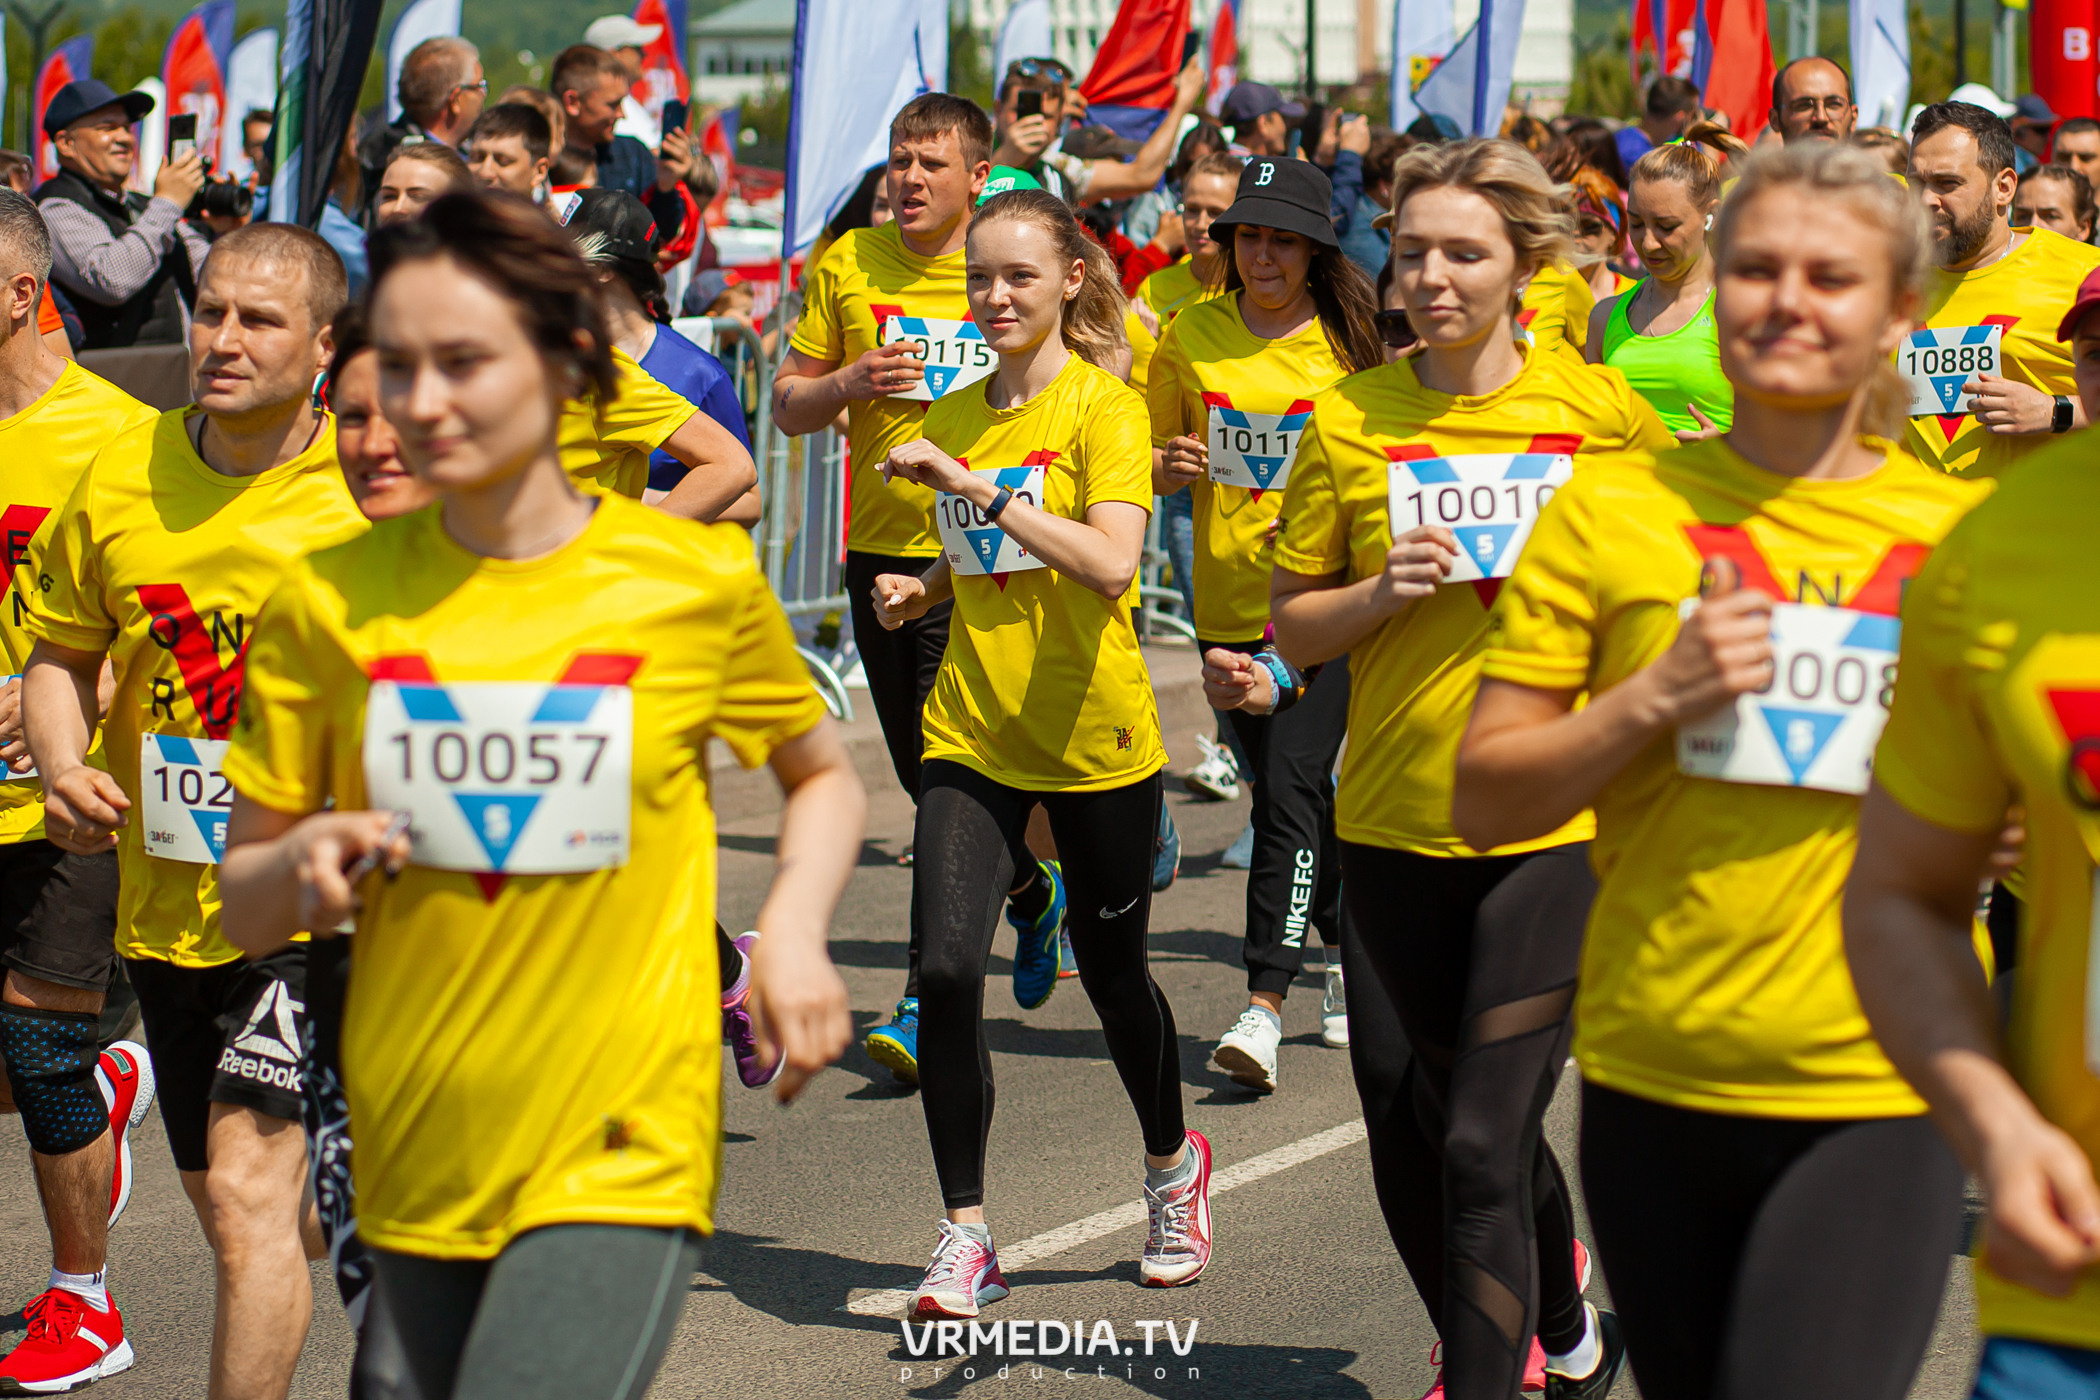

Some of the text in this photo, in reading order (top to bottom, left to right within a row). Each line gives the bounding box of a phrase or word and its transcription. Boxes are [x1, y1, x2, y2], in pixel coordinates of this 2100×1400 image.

[1255, 162, 1275, 186] B
[1907, 346, 1994, 375] 10888
[933, 373, 944, 386] 5
[1944, 383, 1954, 397] 5
[1217, 427, 1299, 455] 1011
[1259, 463, 1269, 475] 5
[980, 538, 991, 554] 5
[1476, 534, 1495, 555] 5
[391, 732, 610, 784] 10057
[213, 822, 227, 842] 5
[216, 1047, 302, 1092] Reebok
